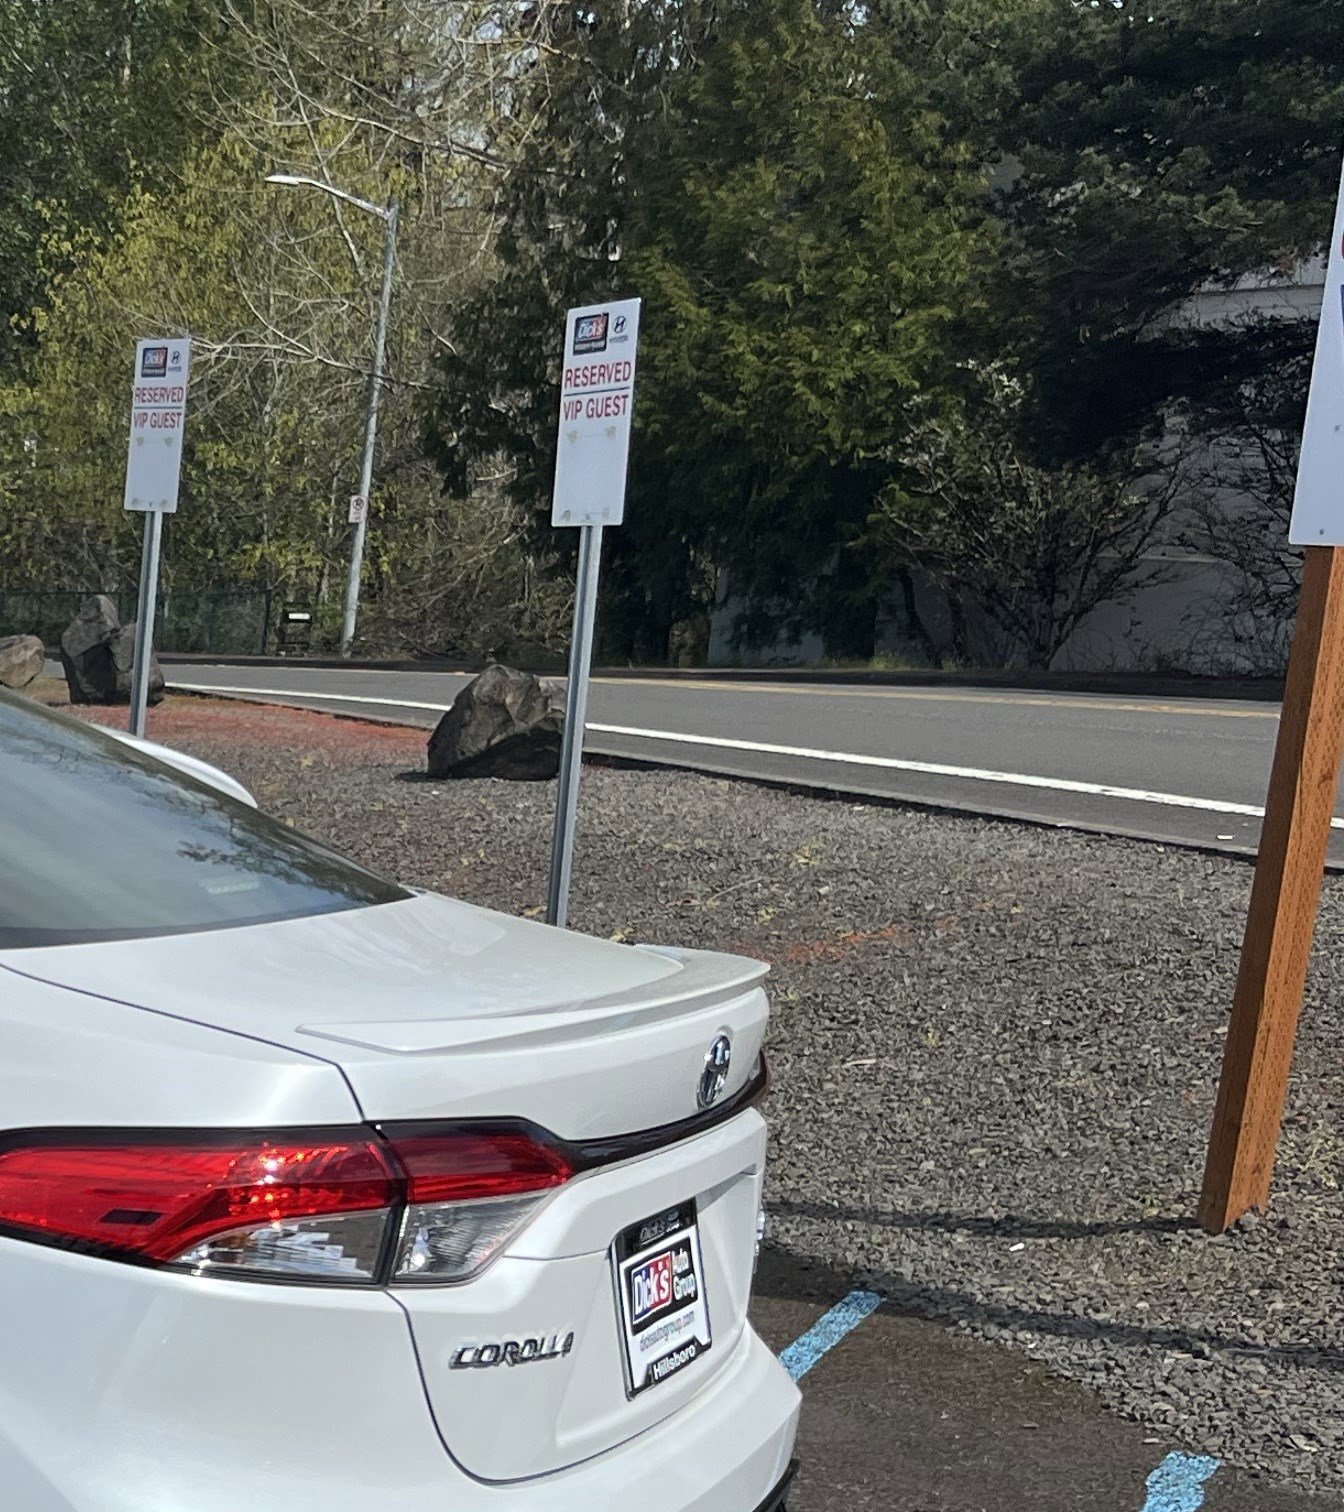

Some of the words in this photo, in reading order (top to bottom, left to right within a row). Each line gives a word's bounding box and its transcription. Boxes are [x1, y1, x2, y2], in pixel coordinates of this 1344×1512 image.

[564, 361, 632, 389] RESERVED
[134, 387, 184, 403] RESERVED
[563, 400, 583, 421] VIP
[586, 395, 629, 419] GUEST
[134, 412, 149, 428] VIP
[151, 412, 182, 429] GUEST
[634, 1260, 669, 1316] Dick's
[673, 1273, 696, 1300] Group
[448, 1331, 574, 1370] COROLLA
[653, 1345, 696, 1380] Hillsboro
